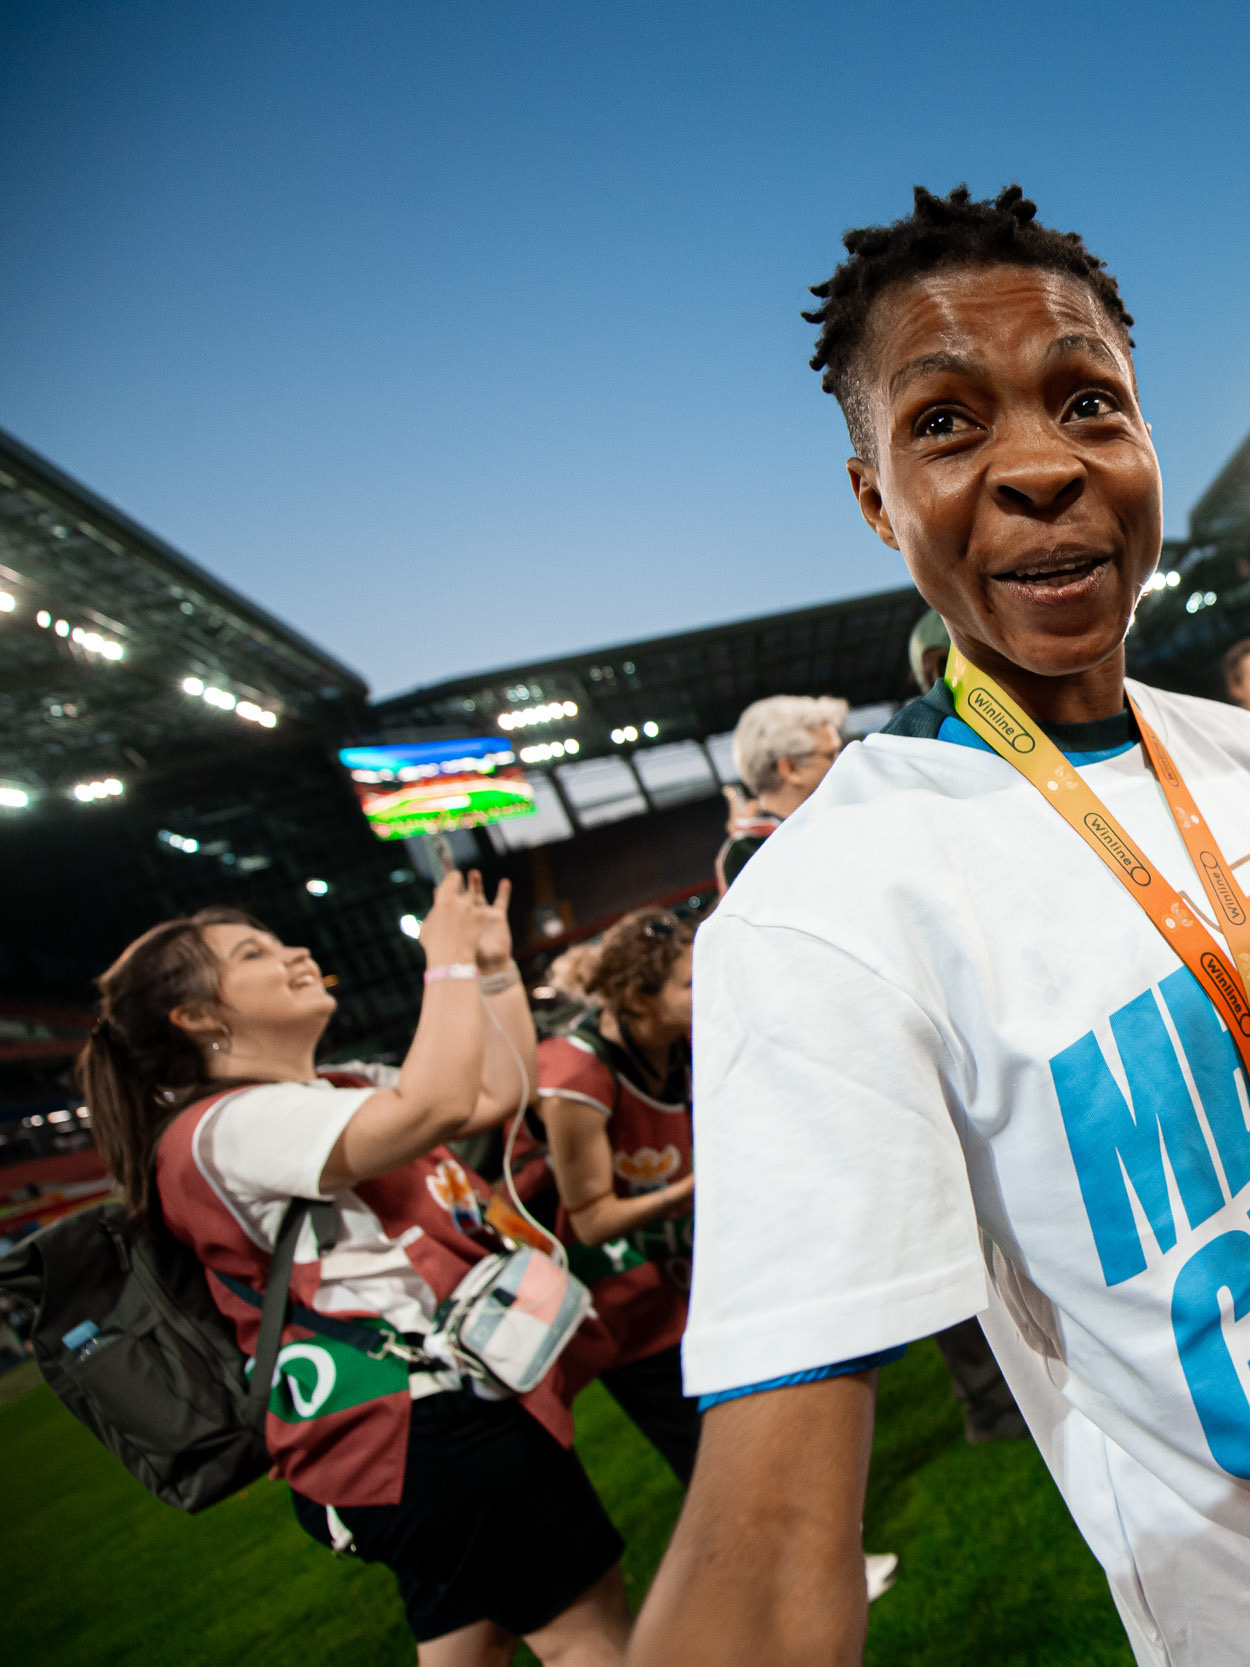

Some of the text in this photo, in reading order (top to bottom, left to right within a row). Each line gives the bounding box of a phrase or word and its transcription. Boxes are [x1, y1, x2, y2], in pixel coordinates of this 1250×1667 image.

[974, 692, 1015, 736] Winline
[1091, 818, 1132, 866] Winline
[1213, 872, 1240, 919] Winline
[1207, 958, 1243, 1014] Winline
